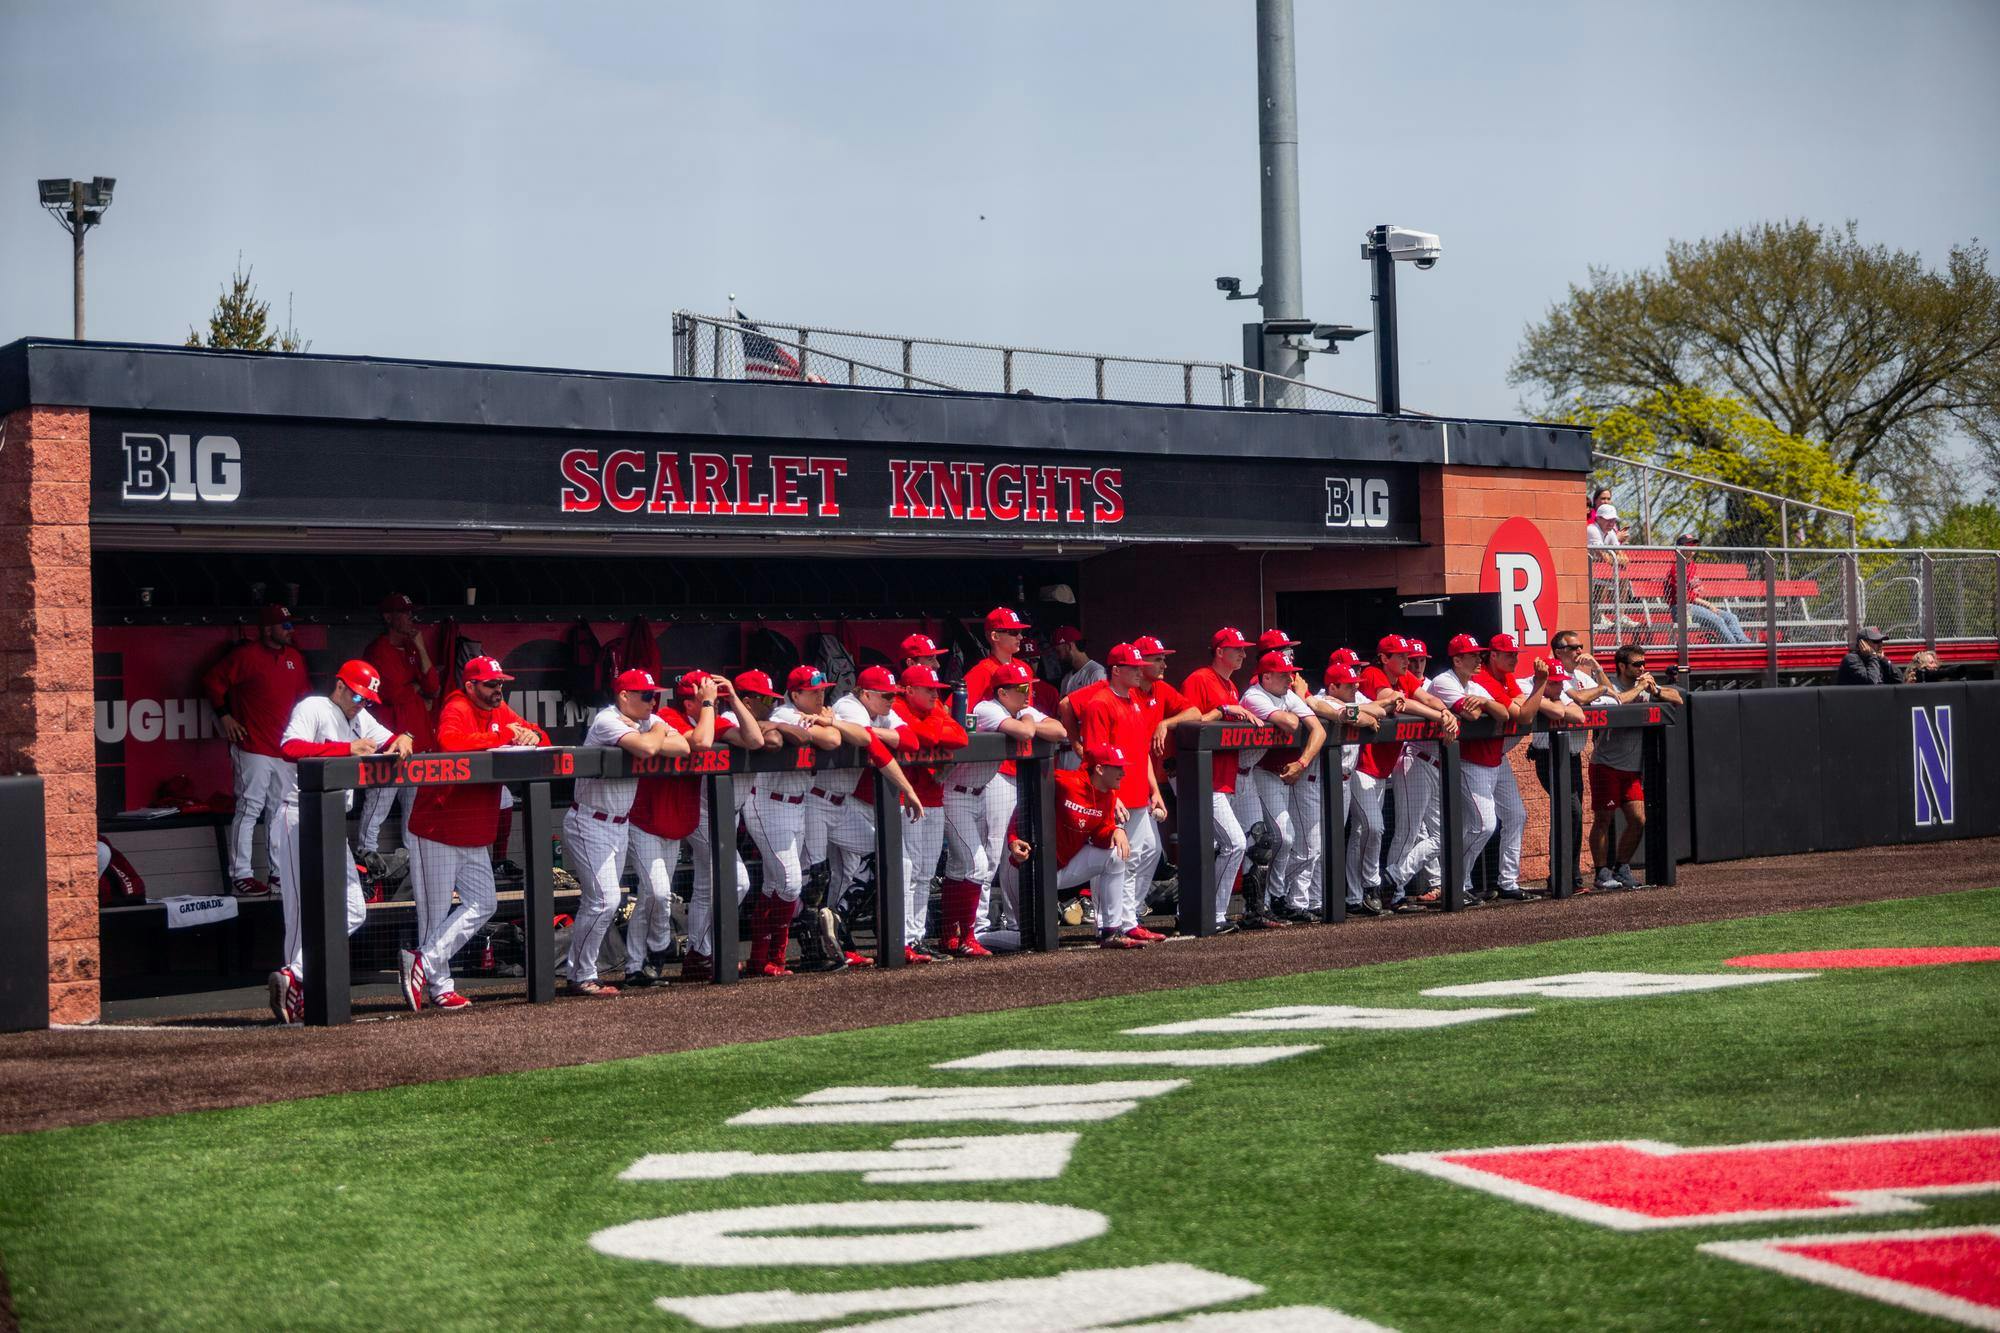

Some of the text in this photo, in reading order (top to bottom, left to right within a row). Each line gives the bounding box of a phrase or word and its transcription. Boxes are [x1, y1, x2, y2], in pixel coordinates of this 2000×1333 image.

[560, 449, 1124, 523] SCARLET KNIGHTS
[1495, 551, 1547, 646] R
[281, 607, 291, 617] R
[1010, 612, 1020, 622] R
[1468, 637, 1478, 647] R
[1025, 643, 1035, 652] R
[1413, 643, 1423, 652] R
[1133, 649, 1142, 659] R
[1350, 651, 1359, 661] R
[286, 660, 295, 670] R
[490, 660, 502, 672] R
[1555, 664, 1564, 674] R
[1348, 668, 1357, 678] R
[368, 677, 381, 693] R
[1347, 708, 1355, 717] G
[1912, 705, 1954, 826] N
[358, 758, 472, 785] RUTGERS
[179, 899, 224, 914] GATORADE
